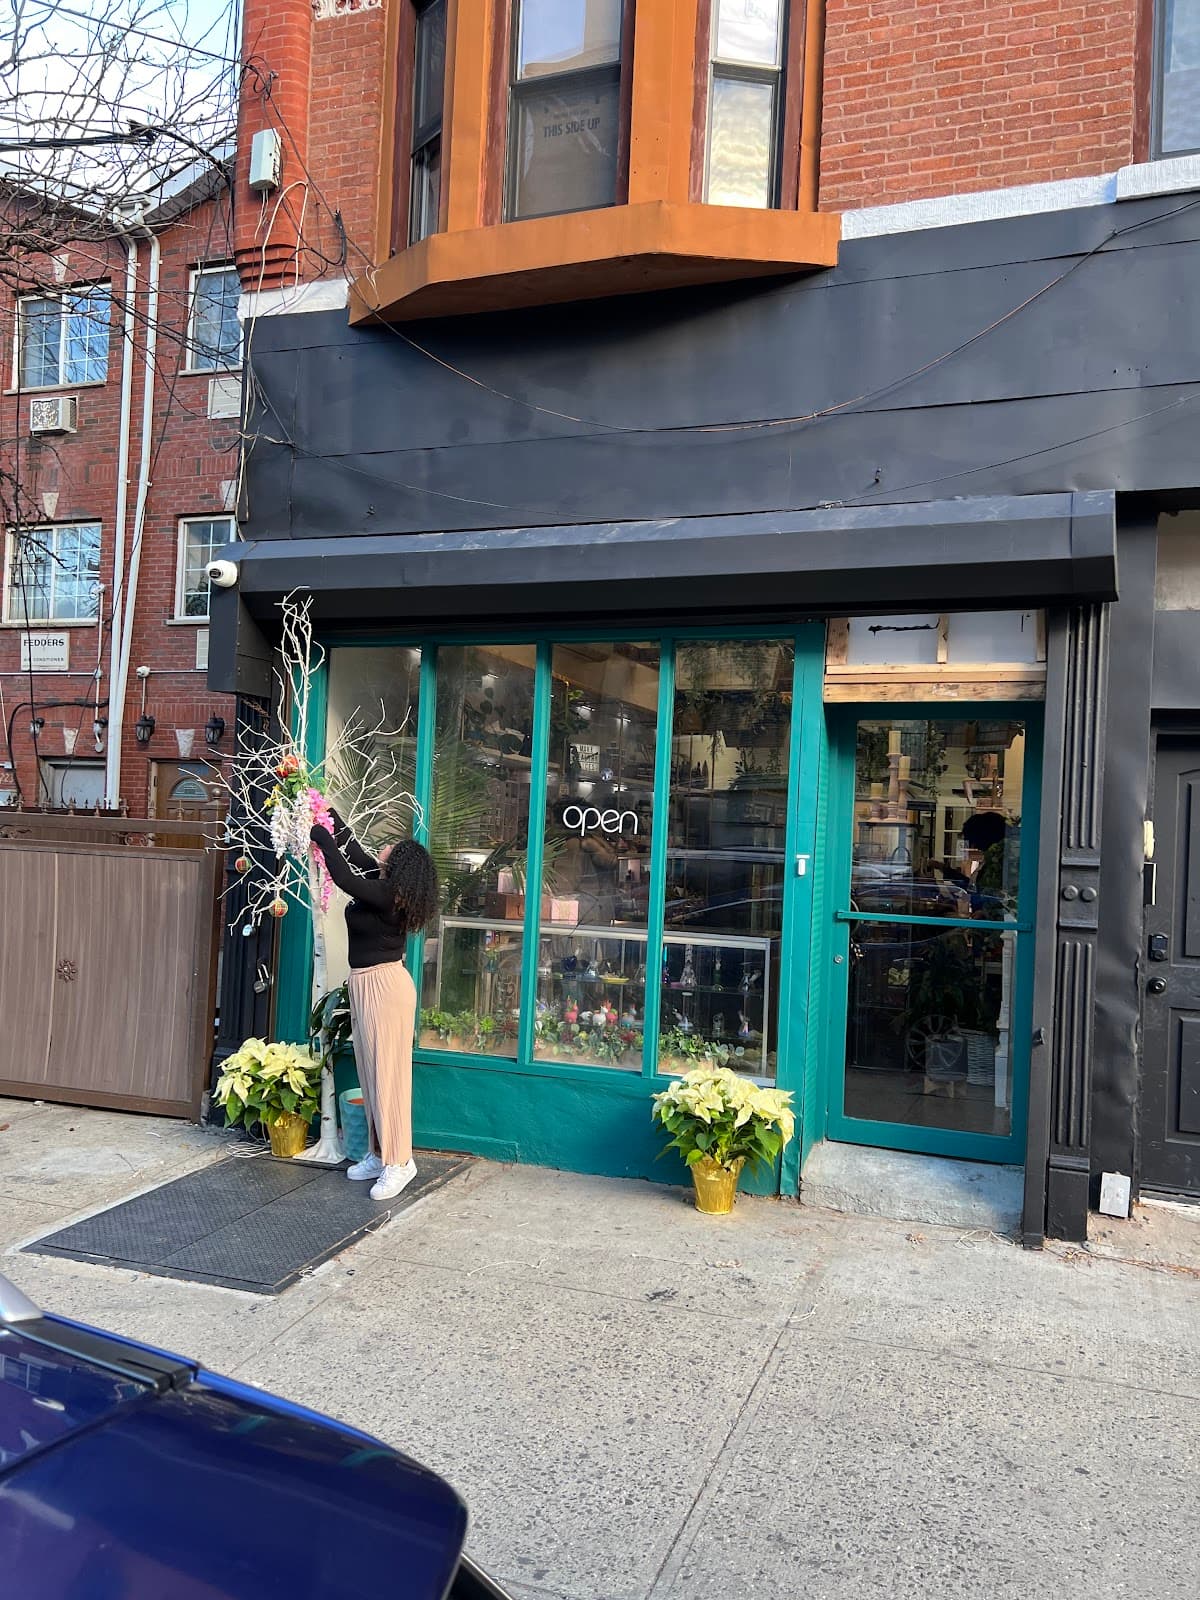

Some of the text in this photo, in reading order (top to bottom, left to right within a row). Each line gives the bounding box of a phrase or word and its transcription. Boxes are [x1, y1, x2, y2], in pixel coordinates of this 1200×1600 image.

[544, 116, 601, 137] THIS SIDE UP
[23, 638, 65, 647] FEDDERS
[563, 806, 638, 837] open
